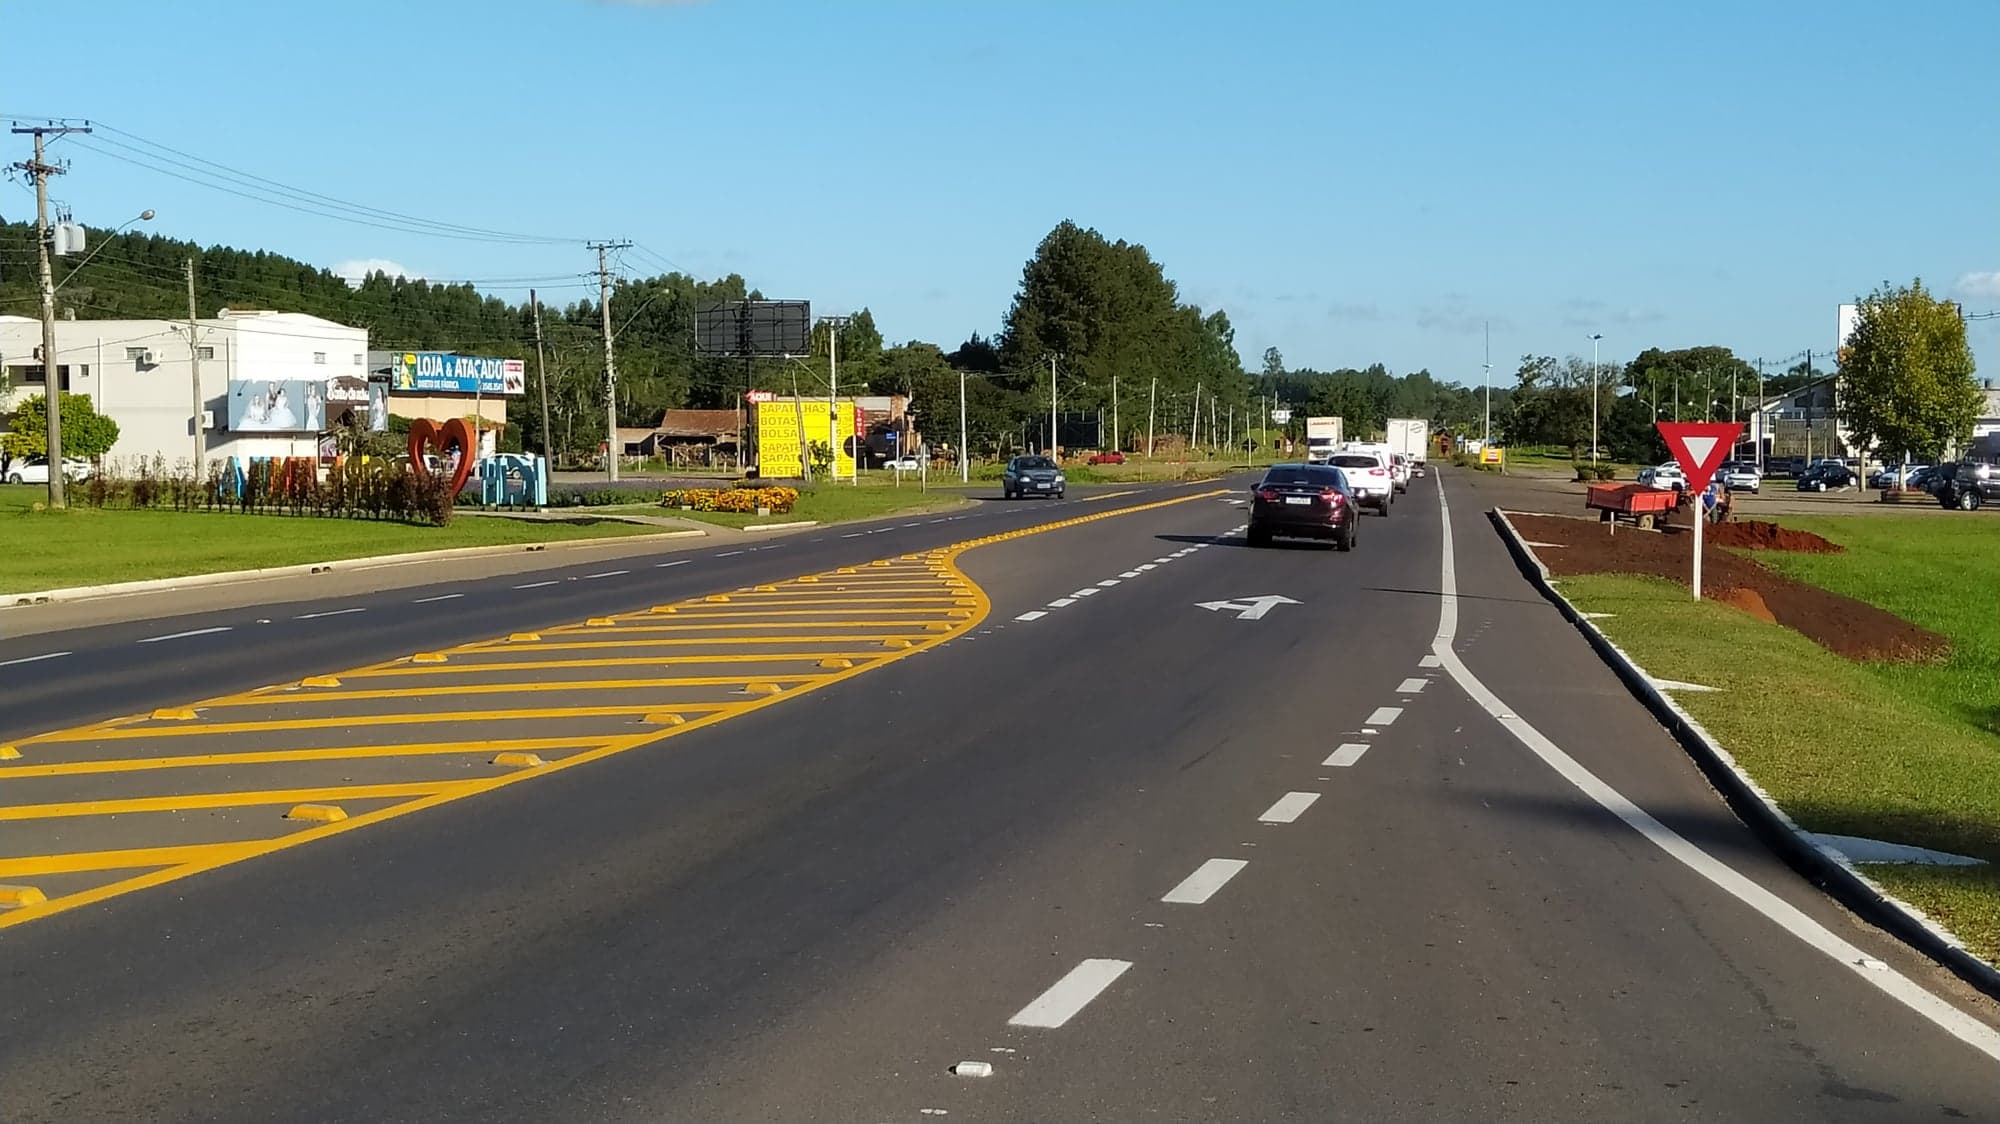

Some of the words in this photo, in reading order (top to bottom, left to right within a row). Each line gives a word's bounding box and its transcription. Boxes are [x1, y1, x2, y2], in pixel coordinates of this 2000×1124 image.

[417, 355, 444, 377] LOJA
[445, 362, 453, 377] &
[455, 356, 503, 378] ATACADO
[760, 404, 826, 413] SAPATHAS
[761, 416, 797, 425] BOTAS
